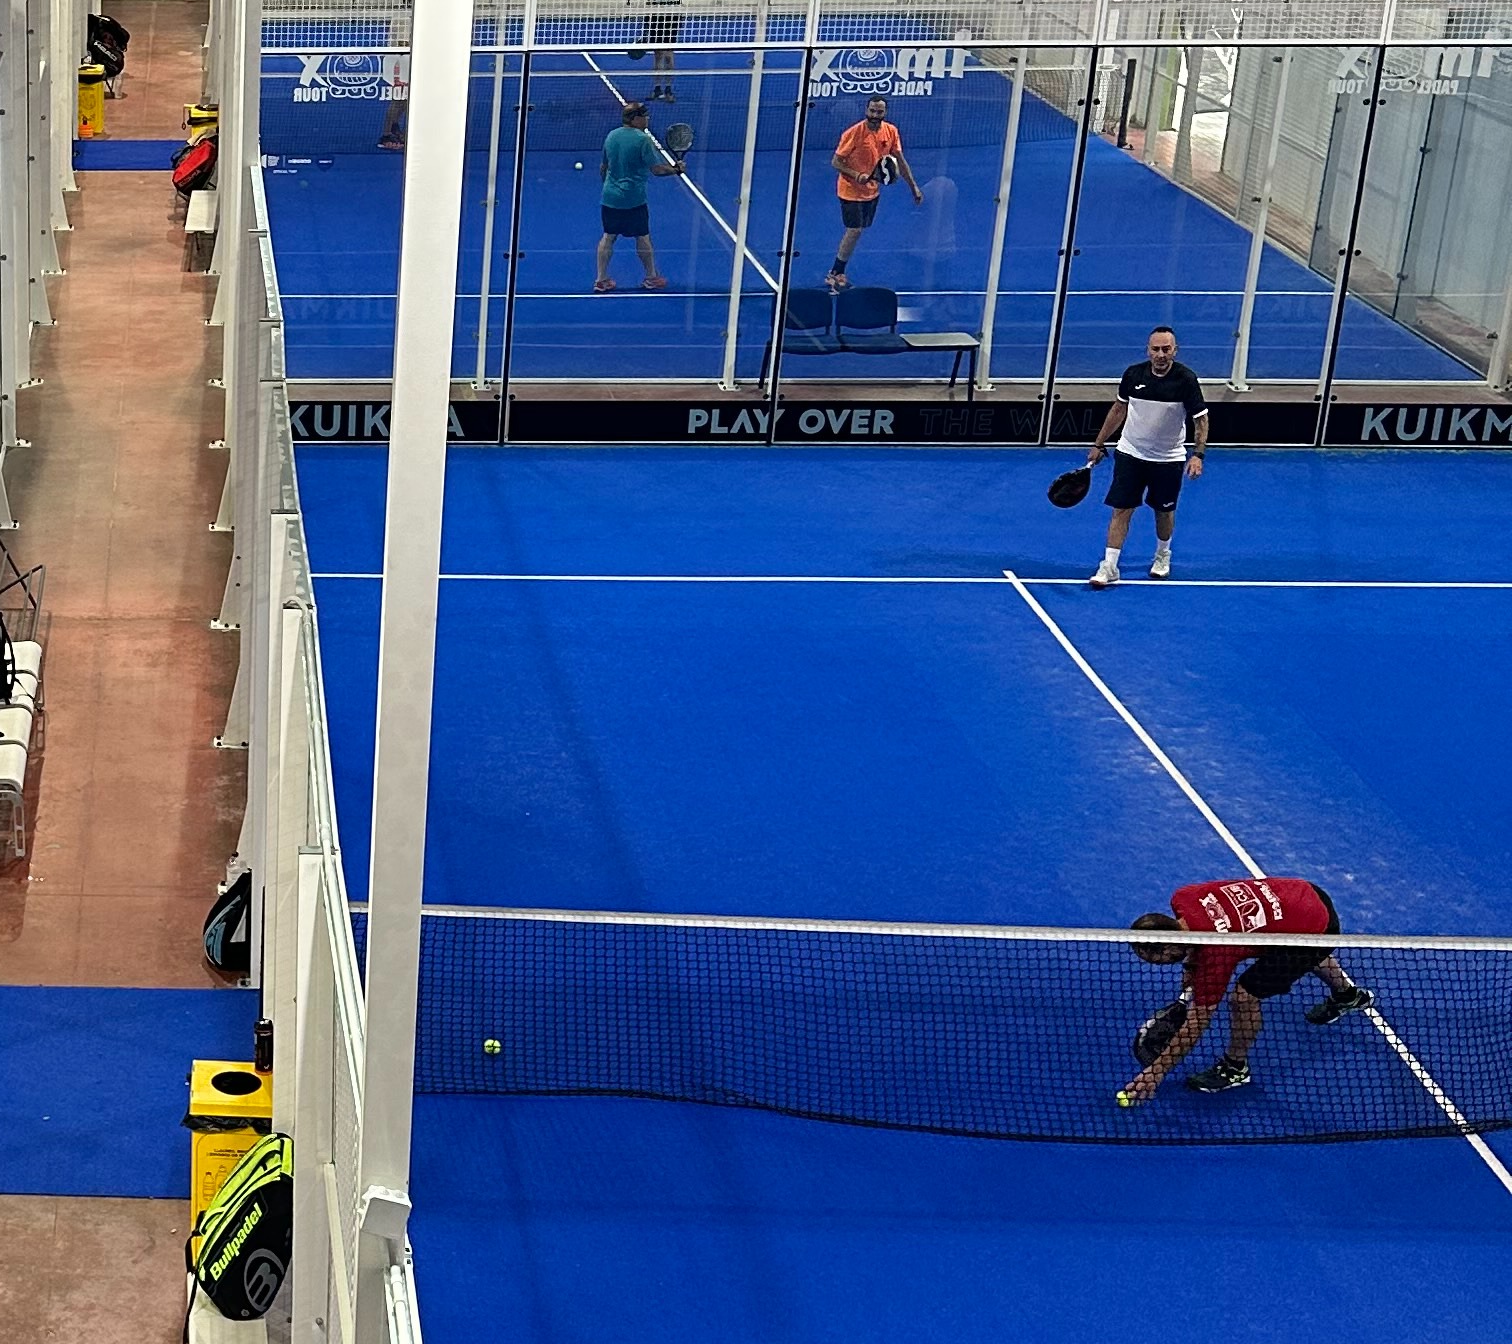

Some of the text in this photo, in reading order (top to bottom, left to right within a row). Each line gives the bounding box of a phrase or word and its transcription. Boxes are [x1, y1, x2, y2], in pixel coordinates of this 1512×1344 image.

[290, 405, 465, 437] KUIKA
[688, 409, 785, 435] PLAY
[798, 409, 895, 435] OVER
[1361, 407, 1512, 441] KUIKM
[210, 1202, 263, 1281] Bullpadel
